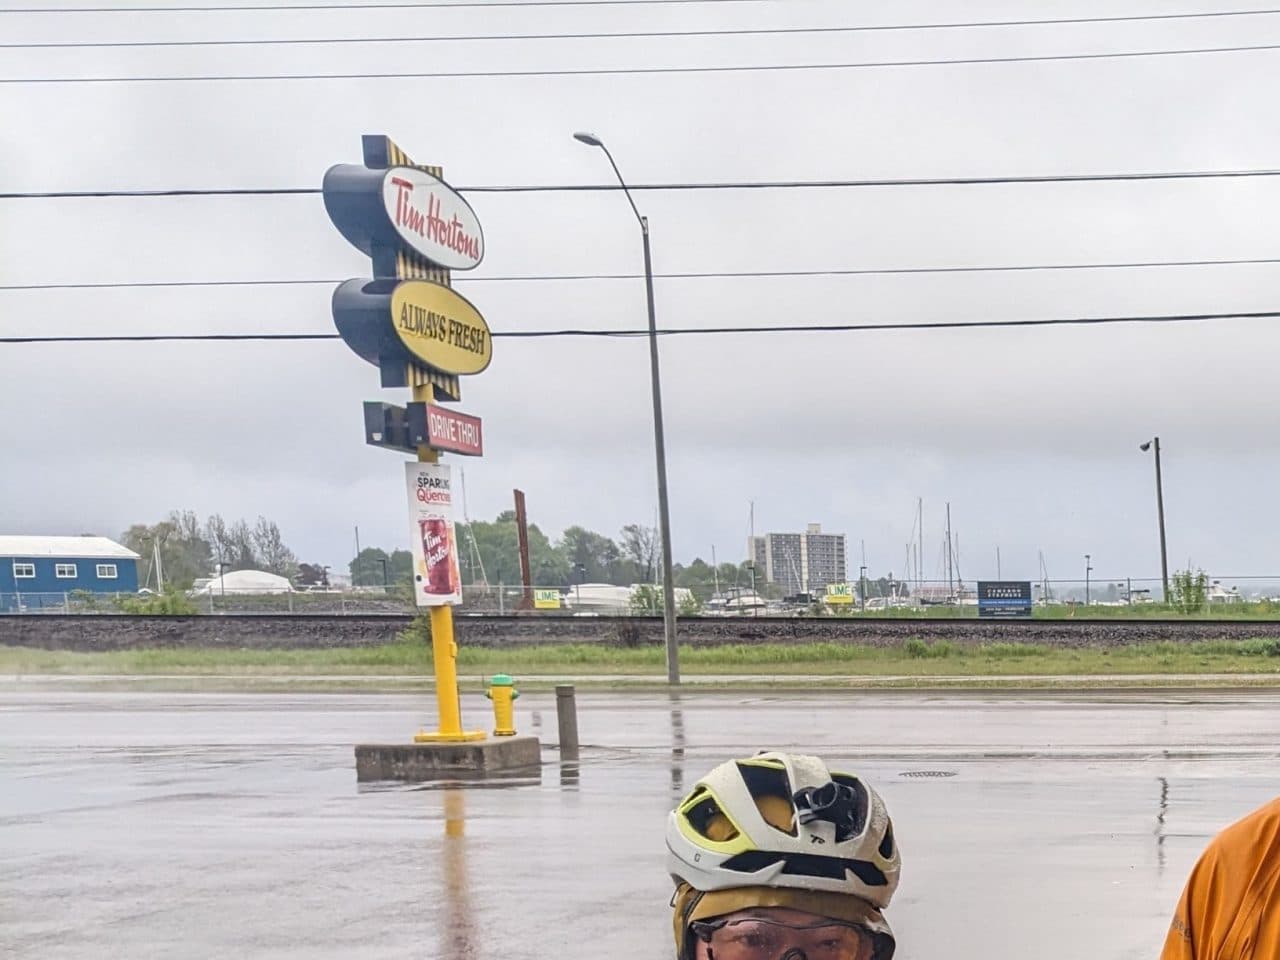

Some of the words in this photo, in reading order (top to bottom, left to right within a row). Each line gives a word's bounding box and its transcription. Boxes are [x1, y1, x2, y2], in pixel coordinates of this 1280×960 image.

[391, 177, 425, 238] Tim
[427, 192, 480, 262] Hortons
[399, 301, 446, 343] ALWAYS
[448, 319, 486, 357] FRESH
[430, 412, 457, 442] DRIVE
[456, 420, 479, 448] THRU
[535, 591, 558, 601] LIME
